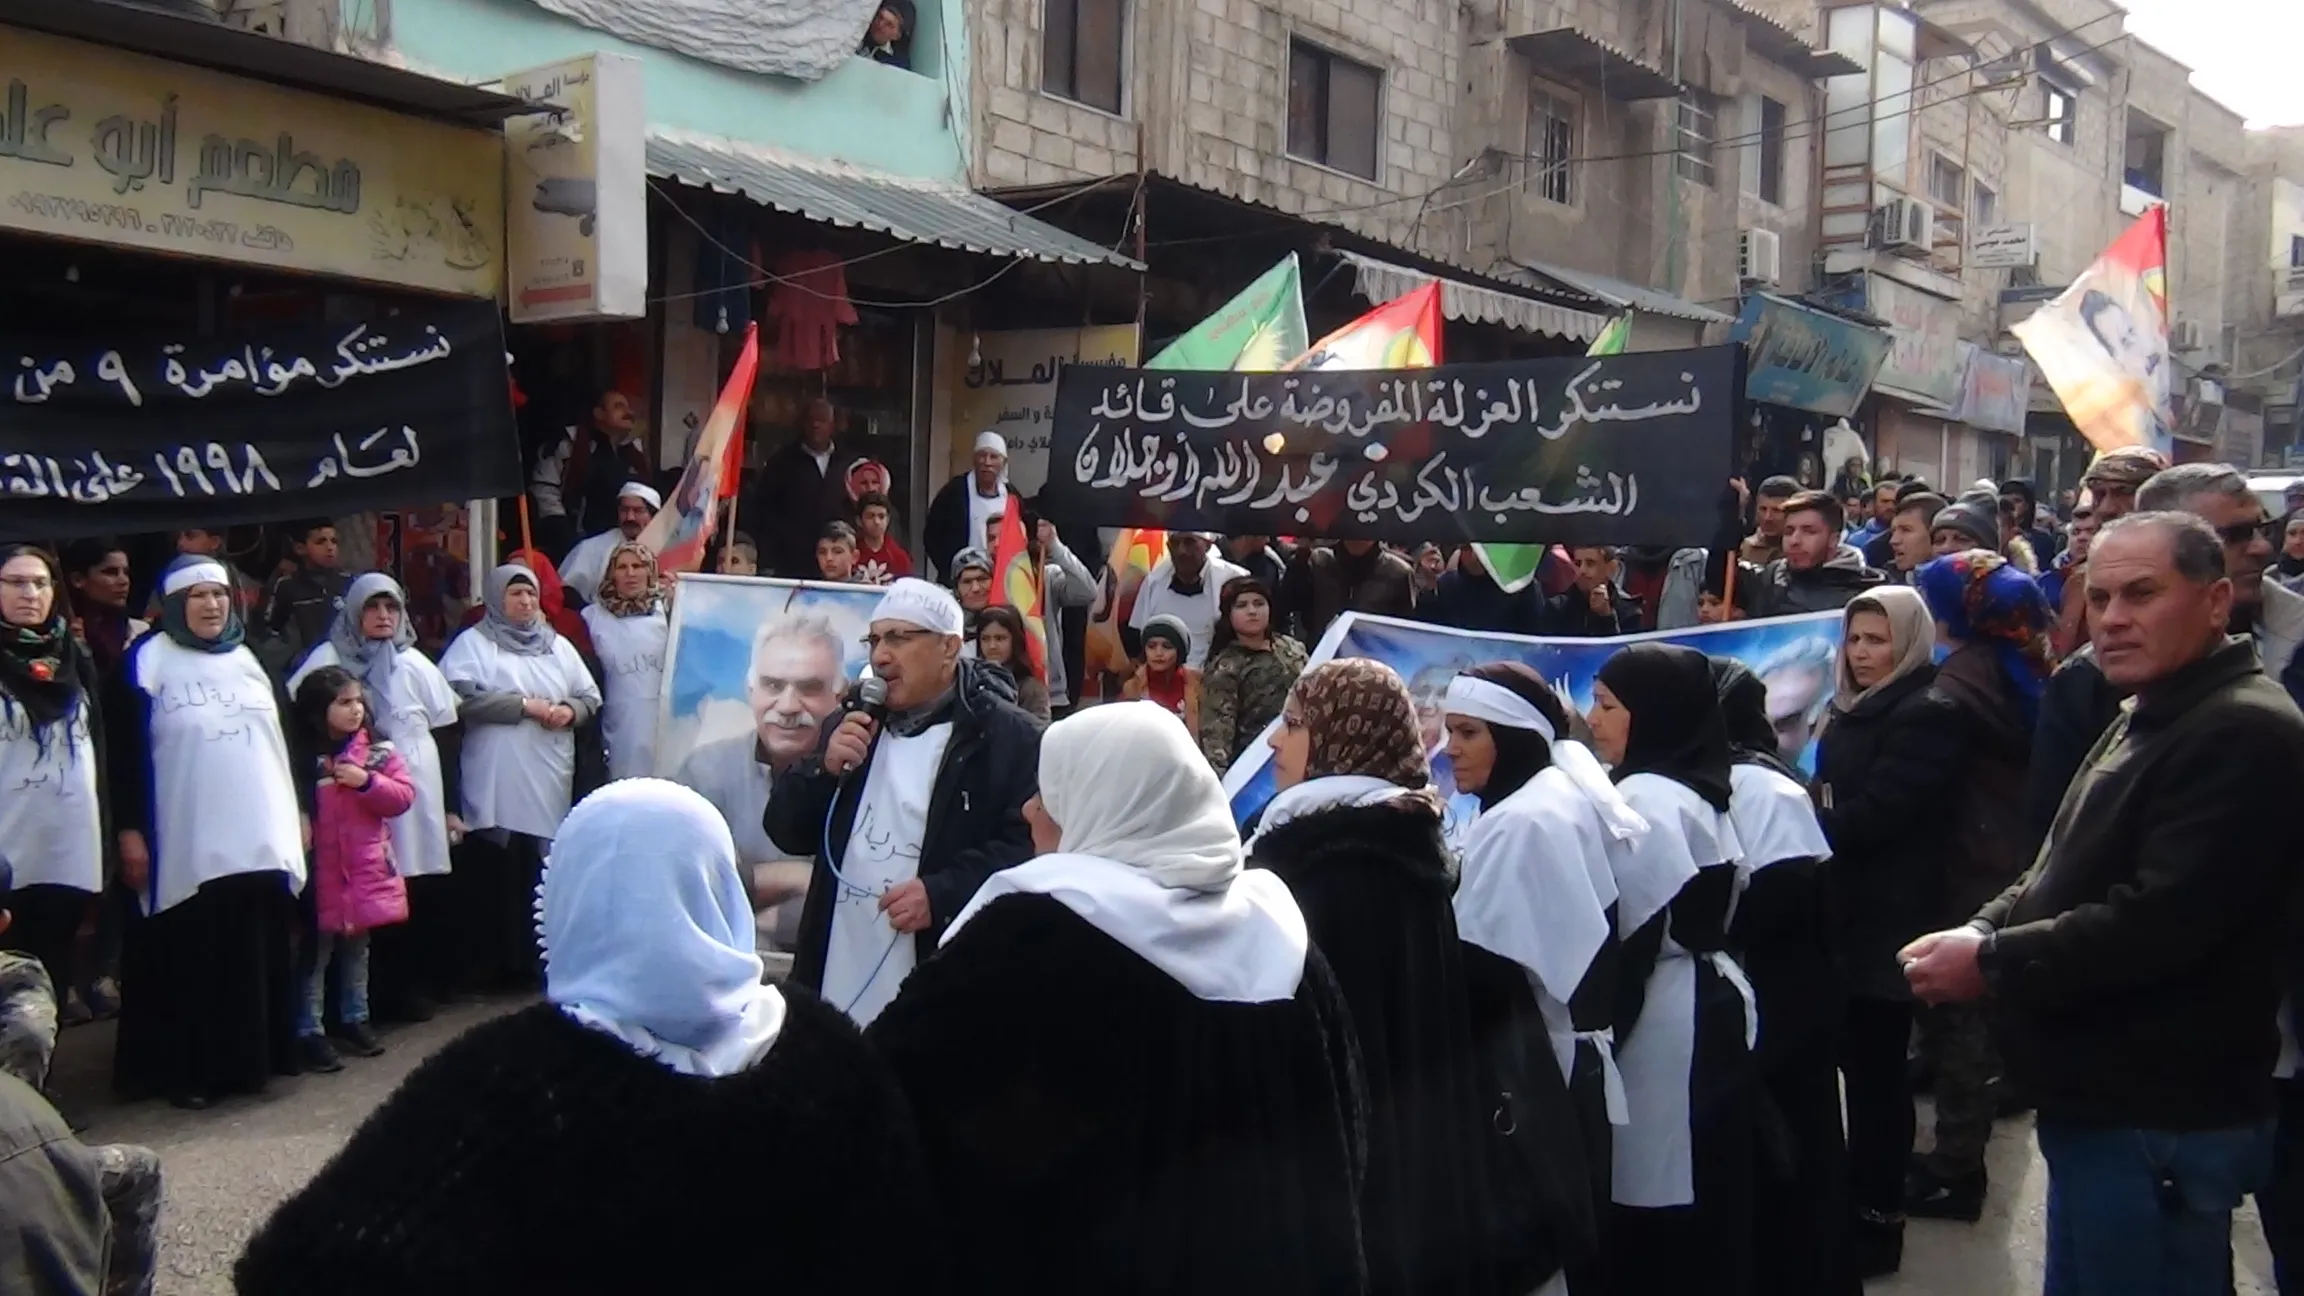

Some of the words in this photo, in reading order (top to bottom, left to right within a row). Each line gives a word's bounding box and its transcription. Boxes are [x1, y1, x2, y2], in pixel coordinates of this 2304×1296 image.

[0, 77, 74, 168] عل
[90, 90, 180, 196] أبو
[187, 130, 361, 216] مطعم
[14, 355, 76, 403] من
[97, 349, 143, 407] ٩
[162, 343, 316, 397] مؤامرة
[315, 323, 451, 389] نستنكر
[1090, 376, 1177, 422] قائد
[1279, 377, 1423, 438] المفروضة
[1427, 377, 1539, 439] العزلة
[1536, 359, 1701, 440] نستنكر
[0, 453, 69, 498] الق
[154, 441, 282, 497] ١٩٩٨
[1346, 450, 1476, 523] الكردي
[1478, 463, 1638, 525] الشعب
